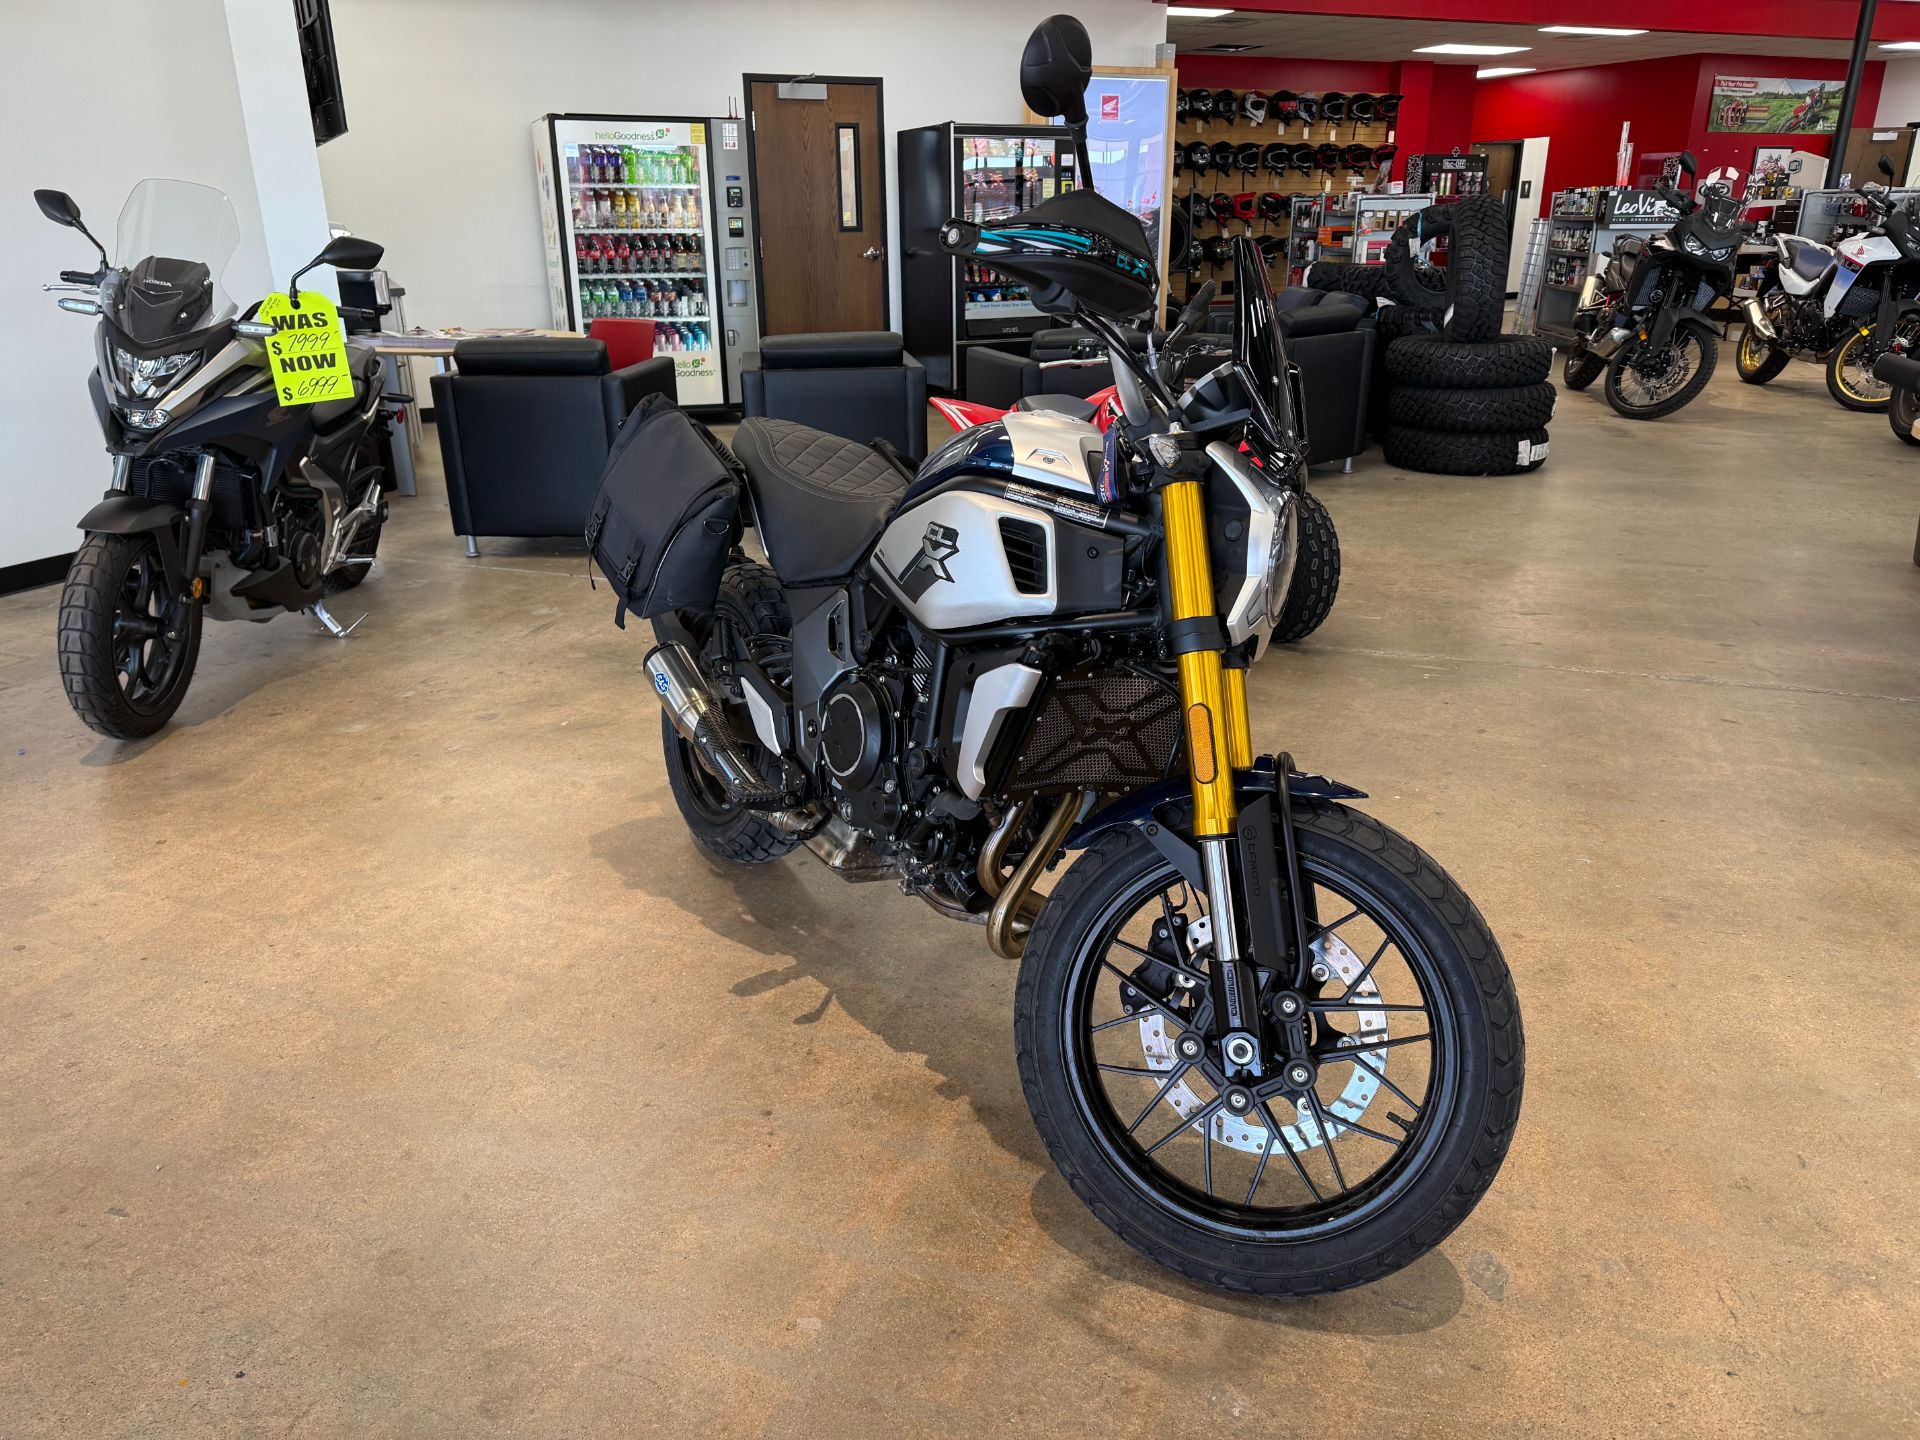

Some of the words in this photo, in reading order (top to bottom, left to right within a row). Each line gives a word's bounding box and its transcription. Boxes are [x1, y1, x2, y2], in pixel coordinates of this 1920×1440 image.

[143, 278, 172, 287] HONDA
[271, 312, 329, 331] WAS
[280, 352, 336, 373] NOW
